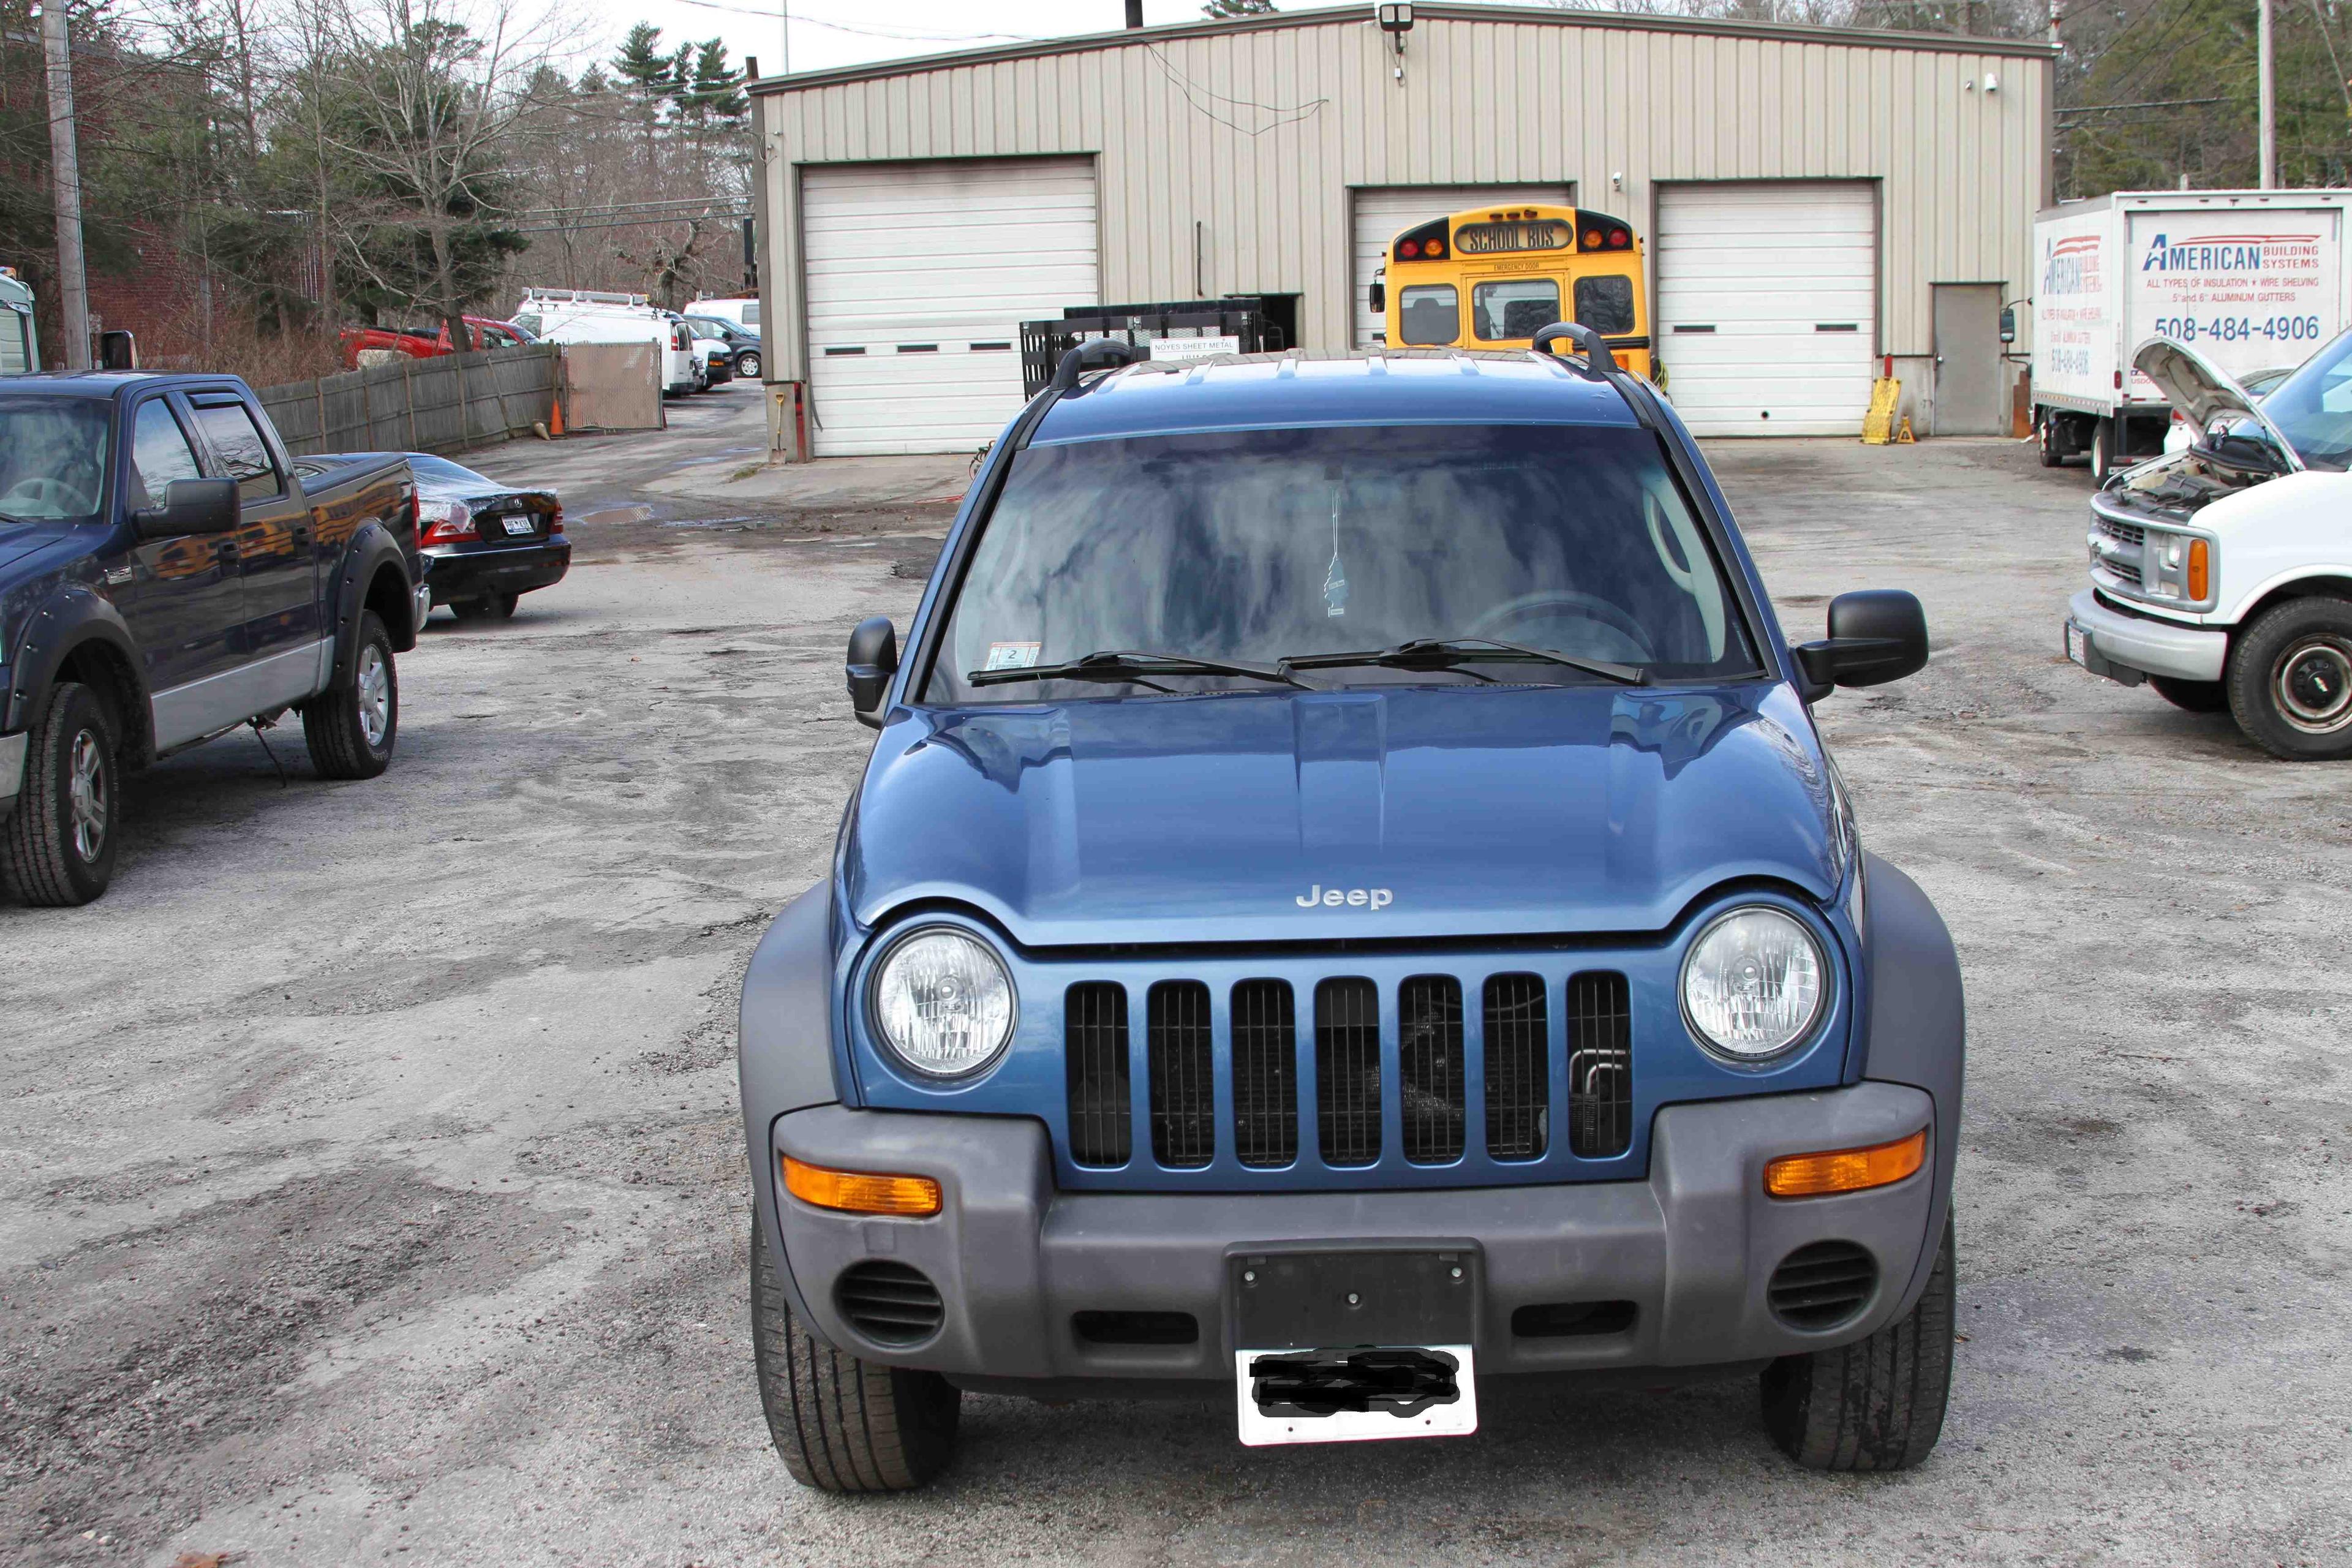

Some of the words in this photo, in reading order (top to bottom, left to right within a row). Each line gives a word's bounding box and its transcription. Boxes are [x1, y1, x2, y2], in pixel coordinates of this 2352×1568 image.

[1470, 227, 1522, 251] SCHOOL
[1528, 225, 1554, 247] BUS
[2142, 234, 2260, 271] AMERICAN
[2263, 246, 2319, 256] BUILDING
[2263, 258, 2319, 269] SYSTEMS
[2146, 279, 2160, 288] ALL
[2163, 279, 2188, 288] TYPES
[2190, 278, 2201, 287] OF
[2203, 278, 2248, 287] INSULATION
[2260, 277, 2279, 287] WIRE
[2282, 277, 2319, 287] SHELVING
[2211, 293, 2255, 302] ALUMINUM
[2258, 292, 2296, 301] GUTTERS
[2155, 315, 2319, 341] 508-484-4906
[1008, 650, 1017, 659] 2
[1296, 884, 1393, 910] Jeep
